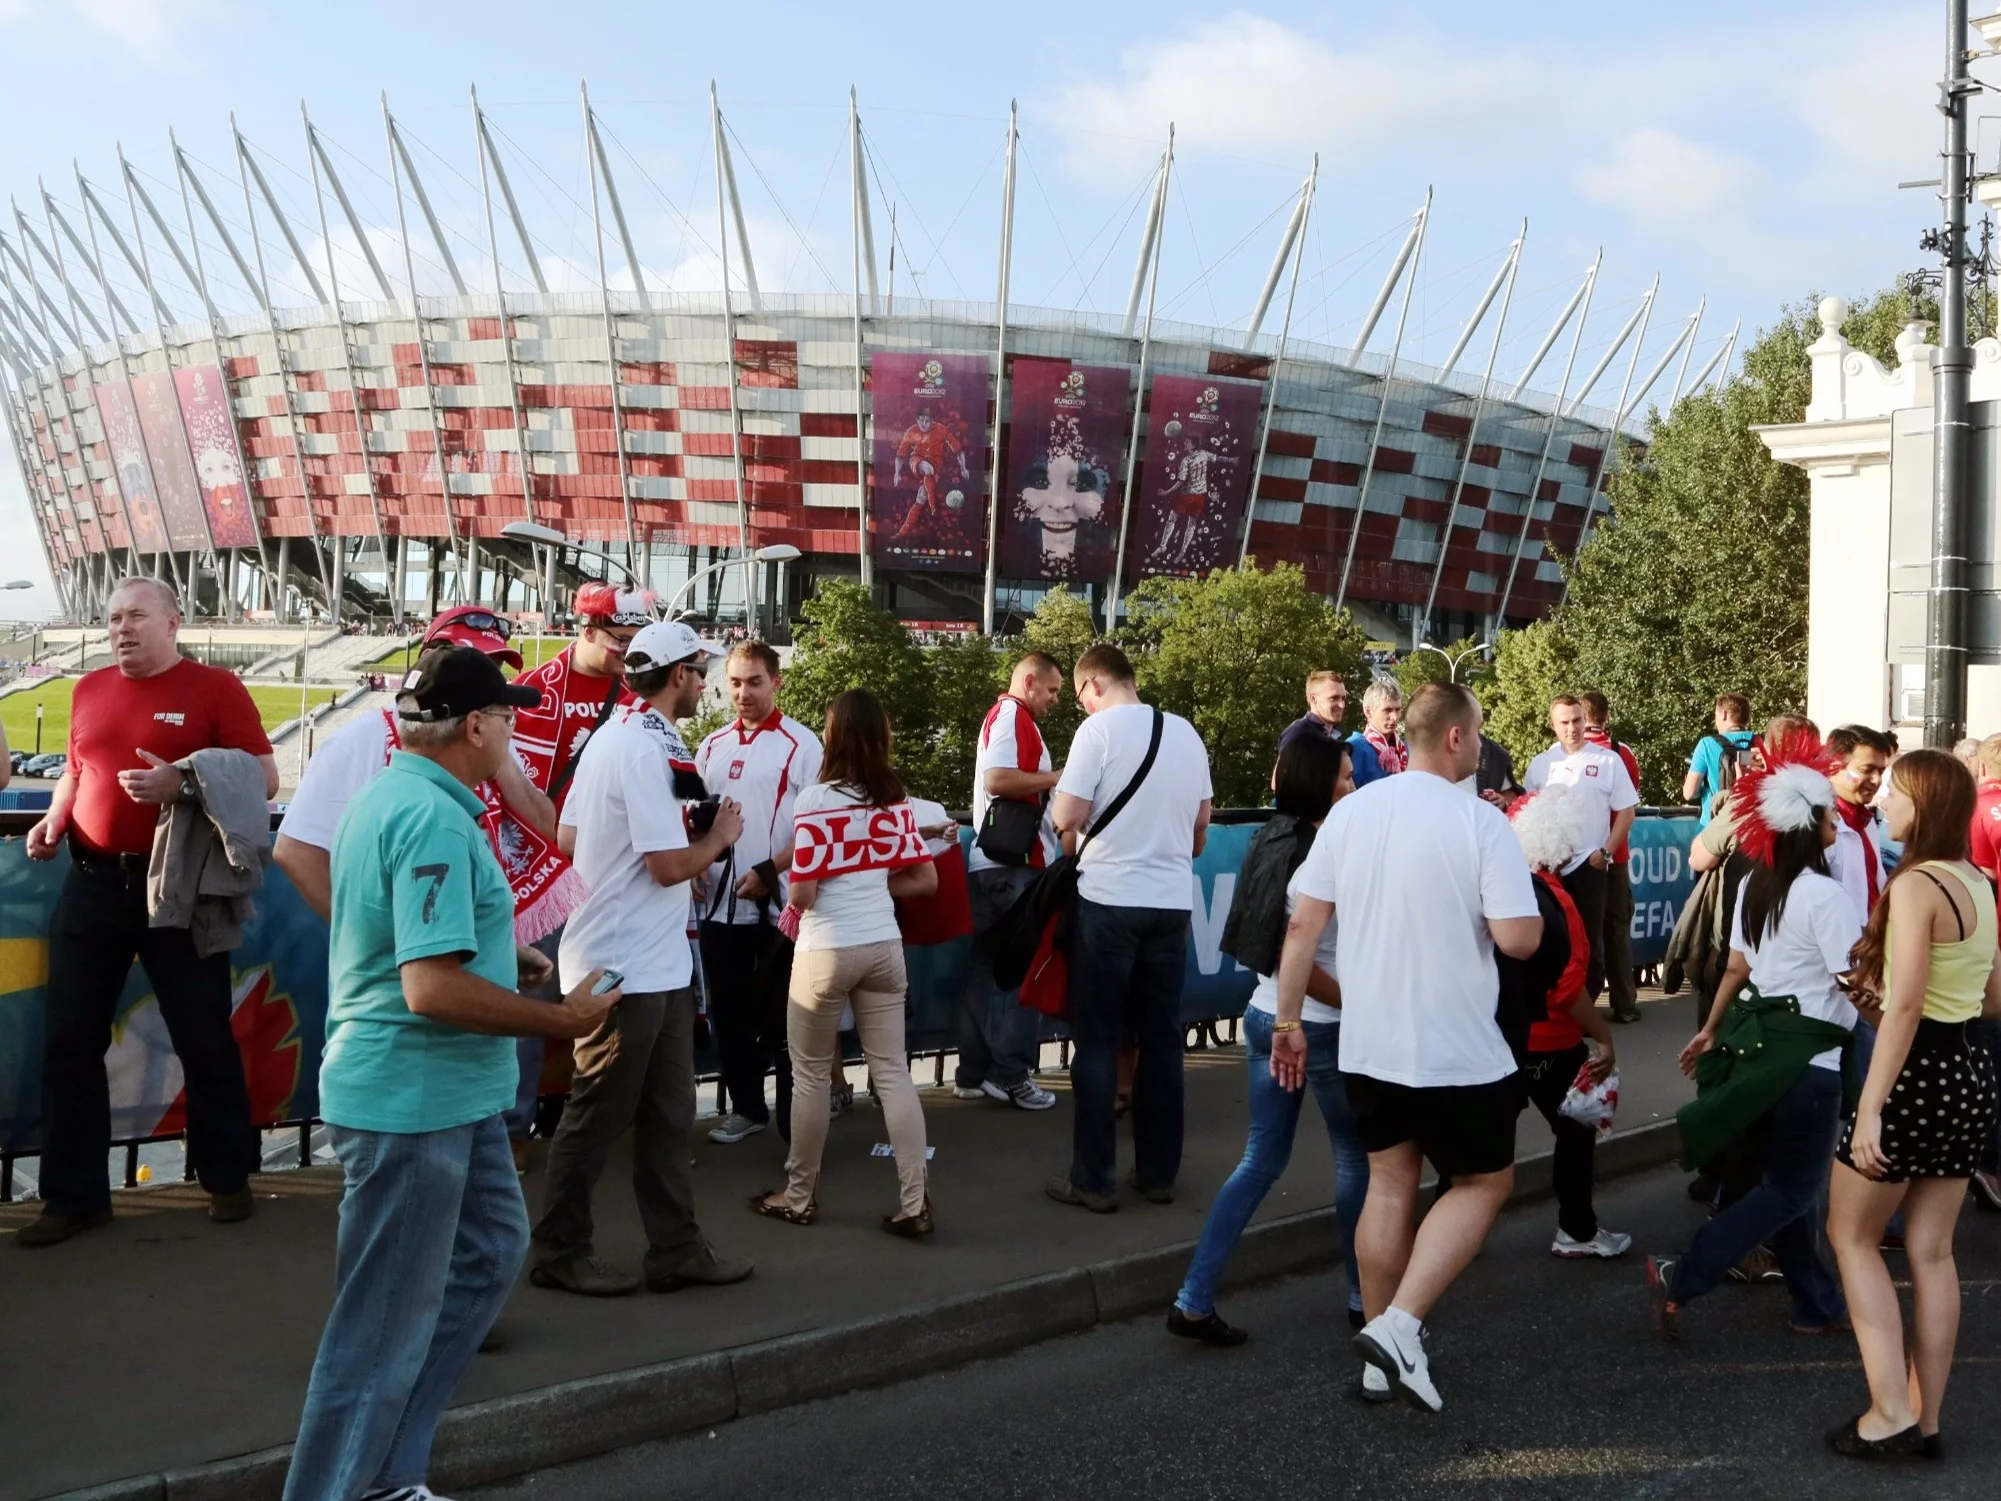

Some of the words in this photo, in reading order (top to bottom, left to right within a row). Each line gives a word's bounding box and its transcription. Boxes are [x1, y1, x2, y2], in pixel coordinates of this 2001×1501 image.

[914, 388, 946, 396] EURO2012
[1054, 397, 1087, 406] EURO2012
[1189, 412, 1220, 421] EURO2012
[481, 630, 505, 645] POLSKA
[512, 856, 563, 906] POLSKA
[411, 862, 451, 925] 7
[1629, 900, 1676, 939] EFA
